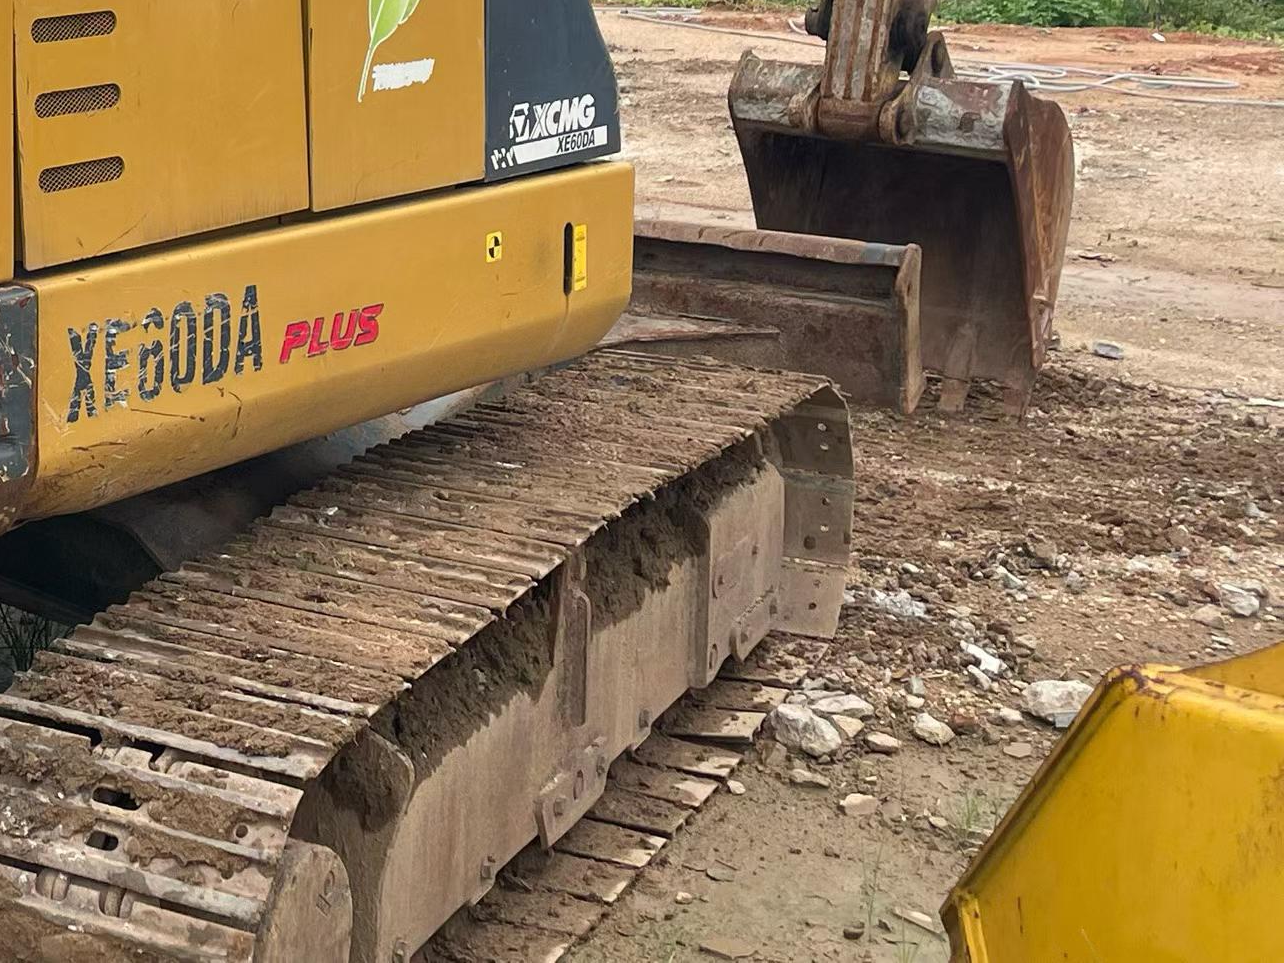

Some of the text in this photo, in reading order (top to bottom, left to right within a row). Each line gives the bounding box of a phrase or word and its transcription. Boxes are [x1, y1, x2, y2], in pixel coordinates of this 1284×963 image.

[529, 93, 596, 140] XCMG
[556, 129, 596, 154] XE60DA
[66, 284, 385, 423] XE60DA PLUS
